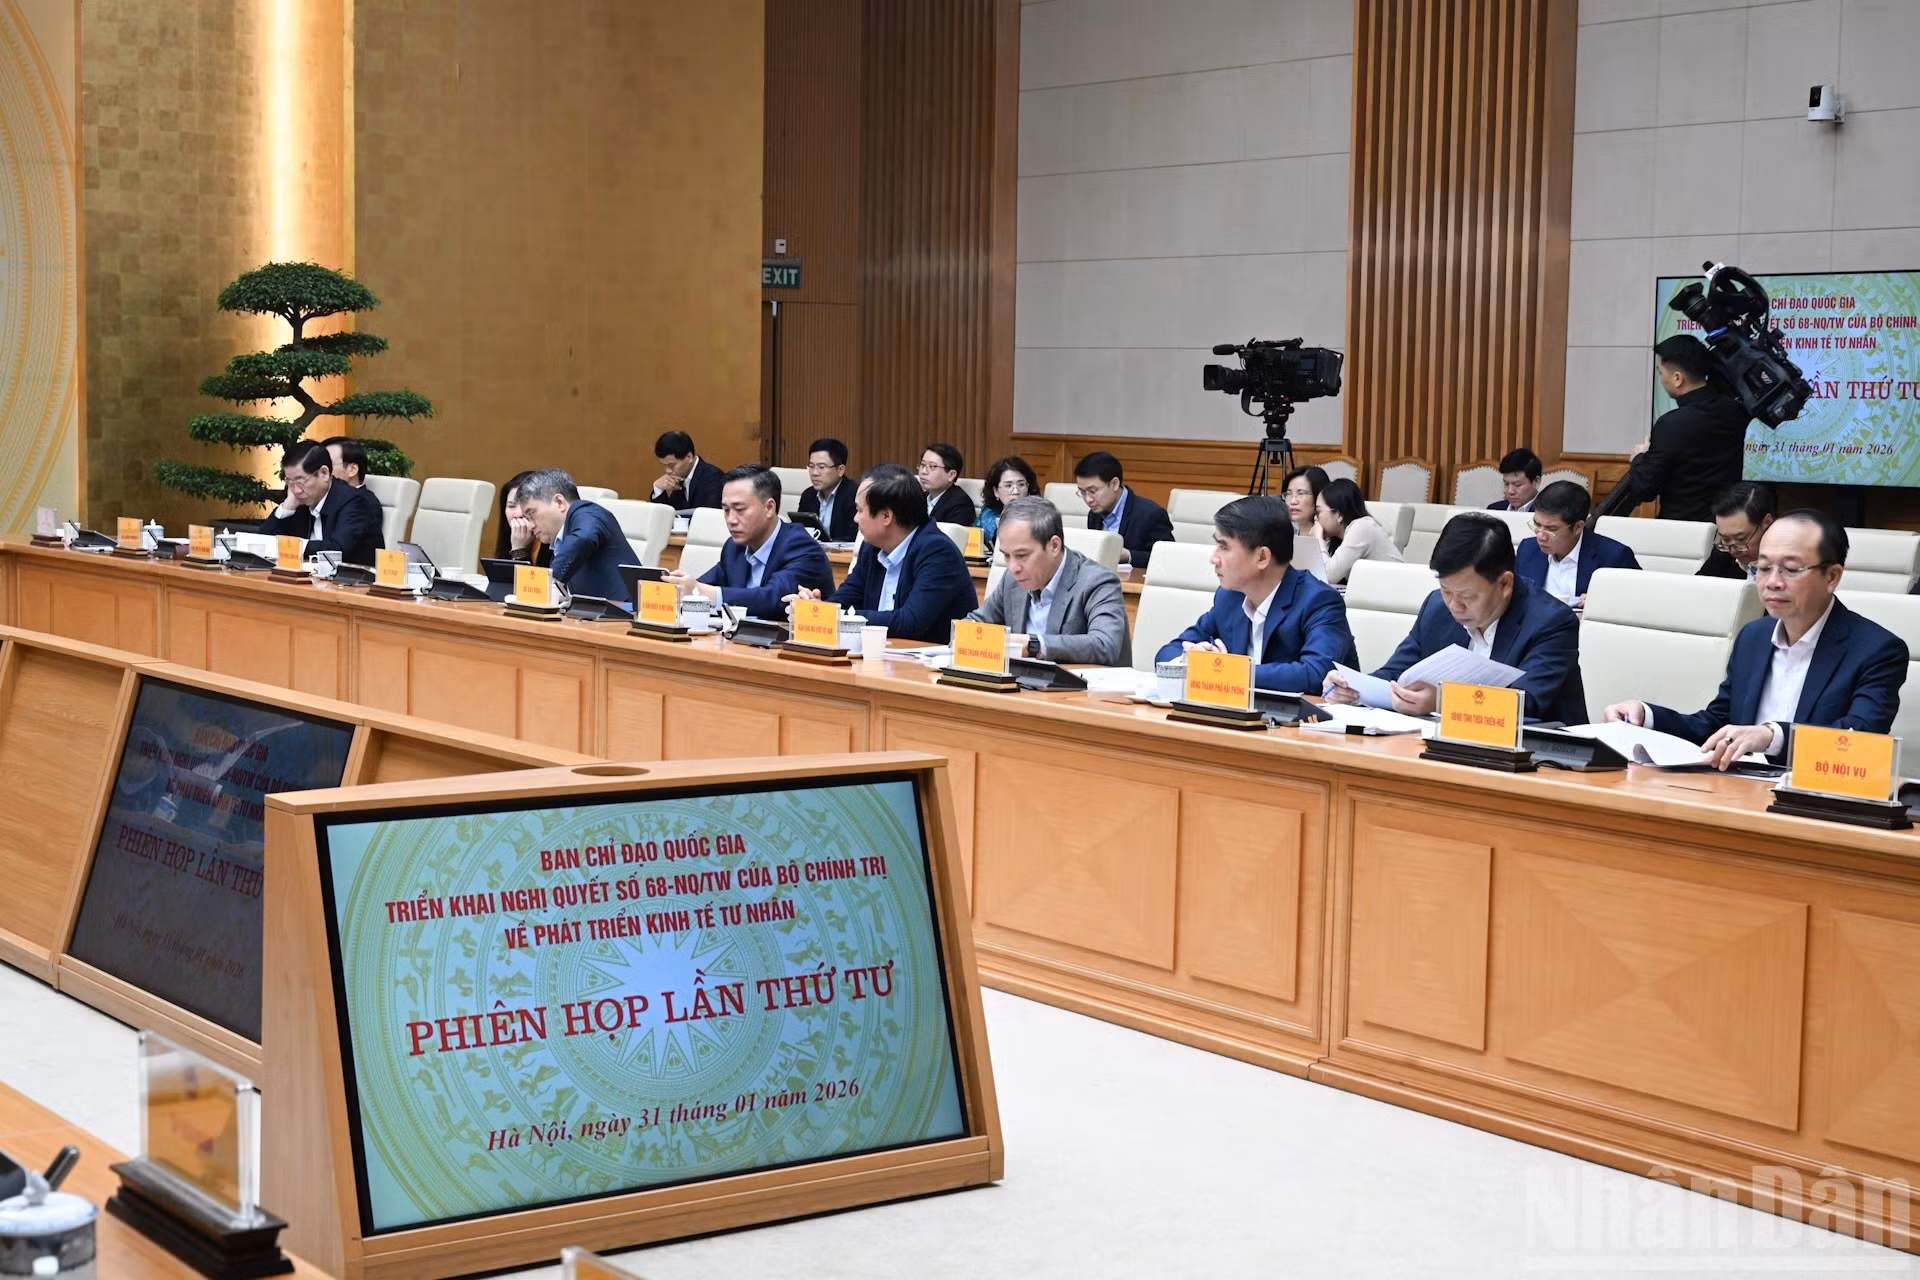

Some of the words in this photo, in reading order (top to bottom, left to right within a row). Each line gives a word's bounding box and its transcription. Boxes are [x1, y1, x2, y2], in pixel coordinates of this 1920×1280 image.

[762, 268, 798, 285] EXIT
[1771, 294, 1787, 309] CHỈ
[1789, 297, 1808, 312] ĐẠO
[1811, 293, 1836, 310] QUỐC
[1839, 297, 1855, 309] GIA
[1783, 314, 1796, 329] SỐ
[1798, 317, 1844, 330] 68-NQ/TW
[1847, 313, 1867, 329] CỦA
[1870, 314, 1883, 331] BỘ
[1886, 313, 1917, 329] CHÍNH
[1795, 337, 1818, 349] KINH
[1821, 333, 1832, 349] TẾ
[1835, 336, 1847, 349] TƯ
[1849, 334, 1876, 349] NHÂN
[1809, 370, 1840, 399] ẦN
[1847, 375, 1893, 400] THỨ
[1774, 441, 1785, 452] 31
[1789, 441, 1819, 455] tháng
[1823, 442, 1837, 454] 01
[1866, 443, 1893, 455] 2026
[1551, 743, 1577, 755] BOSCH
[1815, 760, 1830, 775] BỘ
[1832, 762, 1850, 777] NỘI
[1853, 766, 1867, 780] VỤ
[541, 848, 581, 871] BAN
[585, 838, 617, 867] CHỈ
[621, 841, 658, 867] ĐẠO
[663, 830, 711, 861] QUỐC
[715, 833, 746, 855] GIA
[385, 890, 444, 923] TRIỂN
[450, 893, 496, 917] KHAI
[501, 888, 548, 913] NGHỊ
[553, 875, 610, 909] QUYẾT
[615, 871, 641, 901] SỐ
[645, 870, 732, 898] 68-NQ/TW
[737, 861, 773, 889] CỦA
[777, 860, 800, 888] BỘ
[805, 856, 857, 882] CHÍNH
[860, 855, 887, 880] TRỊ
[504, 919, 529, 949] VỀ
[534, 918, 582, 946] PHÁT
[587, 907, 641, 943] TRIỂN
[646, 910, 691, 934] KINH
[694, 901, 715, 929] TẾ
[719, 902, 742, 926] TƯ
[746, 897, 795, 923] NHÂN
[406, 1000, 547, 1057] PHIÊN
[561, 994, 649, 1041] HỌP
[661, 968, 745, 1024] LẦN
[757, 962, 836, 1011] THỨ
[845, 959, 895, 1000] TƯ
[487, 1128, 521, 1151] Hà
[528, 1120, 573, 1148] Nội,
[580, 1113, 632, 1140] ngày
[638, 1106, 661, 1129] 31
[669, 1100, 728, 1124] tháng
[735, 1092, 756, 1114] 01
[764, 1088, 807, 1110] năm
[814, 1077, 860, 1102] 2026
